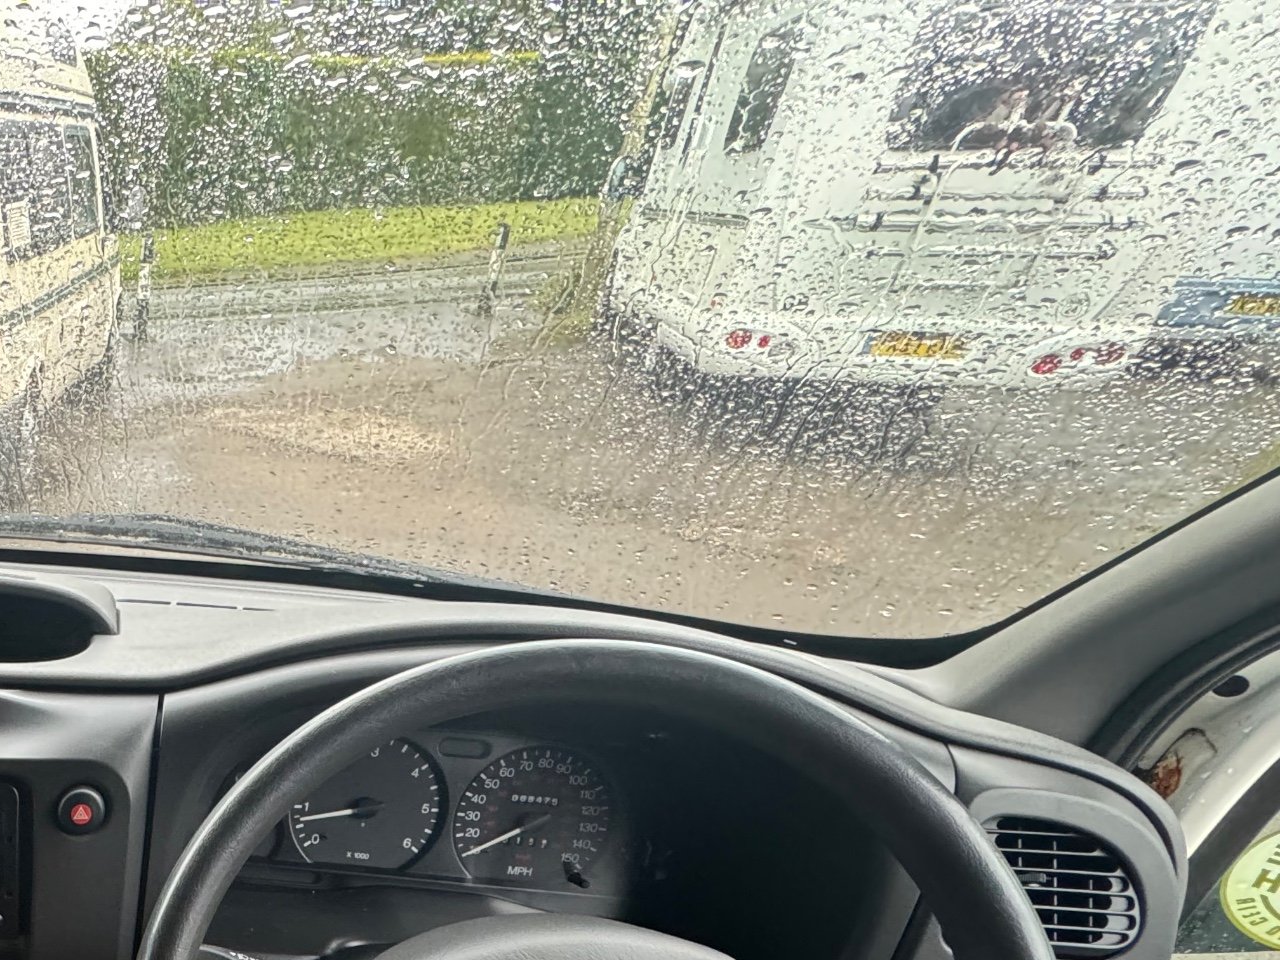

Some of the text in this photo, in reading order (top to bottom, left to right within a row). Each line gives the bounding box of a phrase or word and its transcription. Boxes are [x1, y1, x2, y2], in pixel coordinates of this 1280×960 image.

[520, 761, 533, 771] 70
[538, 759, 554, 769] 80
[556, 764, 571, 774] 90
[411, 769, 419, 778] 4
[500, 768, 514, 778] 60
[484, 779, 499, 789] 50
[569, 775, 587, 785] 100
[471, 794, 486, 804] 40
[421, 803, 429, 813] 5
[465, 812, 480, 821] 30
[579, 823, 597, 832] 130
[466, 828, 480, 838] 20
[311, 834, 320, 844] 0
[403, 838, 411, 848] 6
[561, 852, 579, 863] 150
[507, 865, 533, 877] MPH
